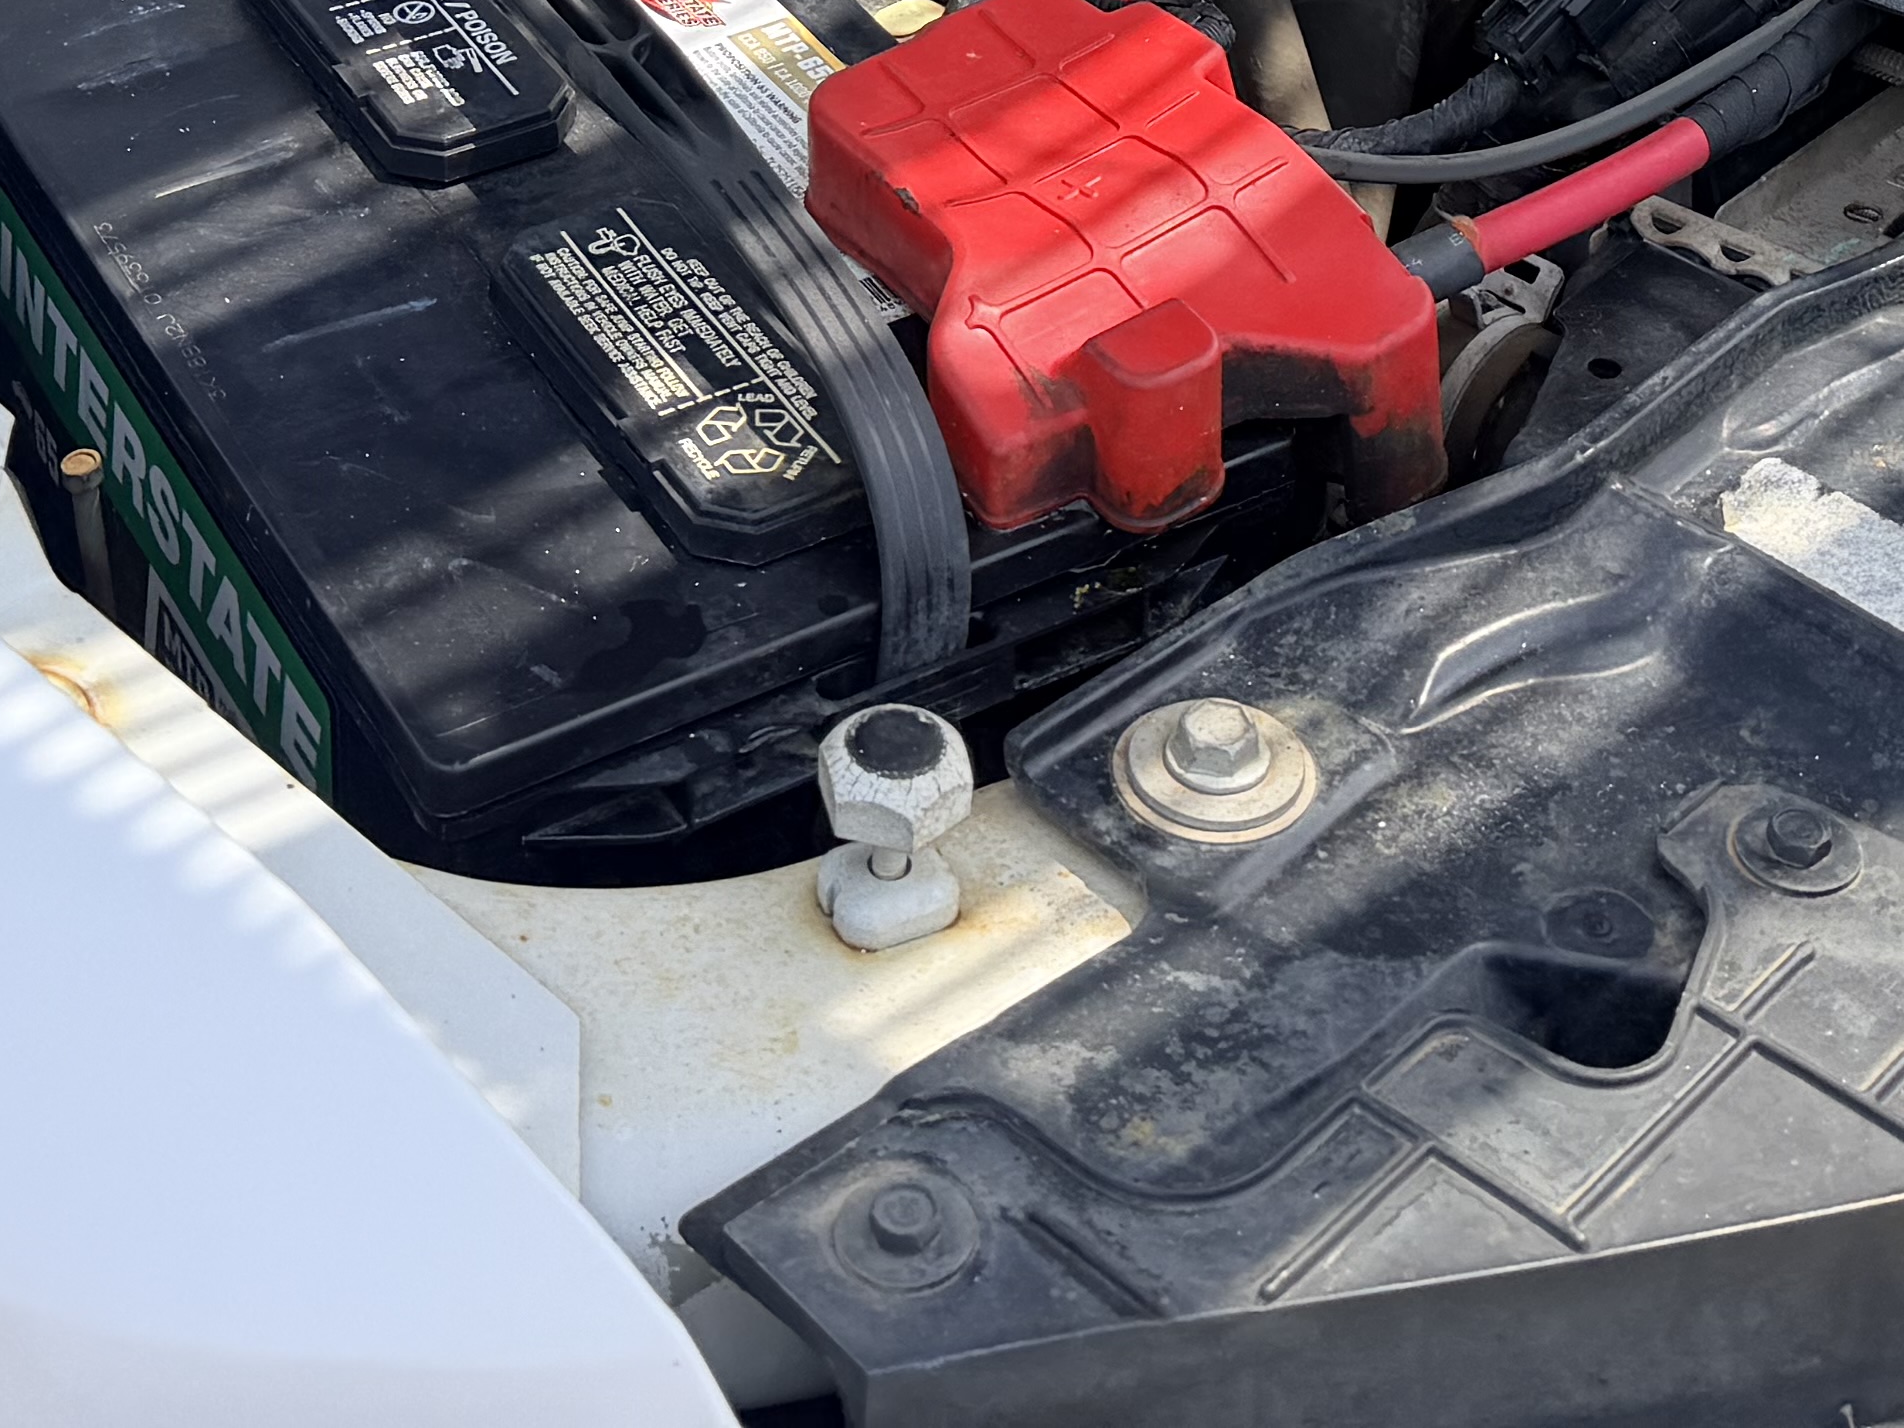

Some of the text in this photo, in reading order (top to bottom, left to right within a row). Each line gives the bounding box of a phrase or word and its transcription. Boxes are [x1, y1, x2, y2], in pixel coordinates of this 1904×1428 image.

[758, 21, 841, 85] MTP-65
[601, 266, 686, 355] MEDICAL HELP FAST
[616, 260, 647, 285] WITH
[666, 317, 694, 338] GET
[633, 254, 741, 368] FLUSH EYES IMMEDIATELY
[660, 247, 678, 260] DO
[670, 259, 692, 276] NOT
[699, 291, 724, 312] KEEP
[774, 377, 797, 395] AND
[702, 277, 725, 295] OUT
[717, 294, 736, 307] OF
[764, 348, 783, 361] OF
[594, 294, 619, 314] SAFE
[656, 366, 689, 398] FOLLOW
[738, 393, 775, 404] LEAD
[678, 437, 721, 481] RECYCLE
[0, 221, 322, 791] INTERSTATE
